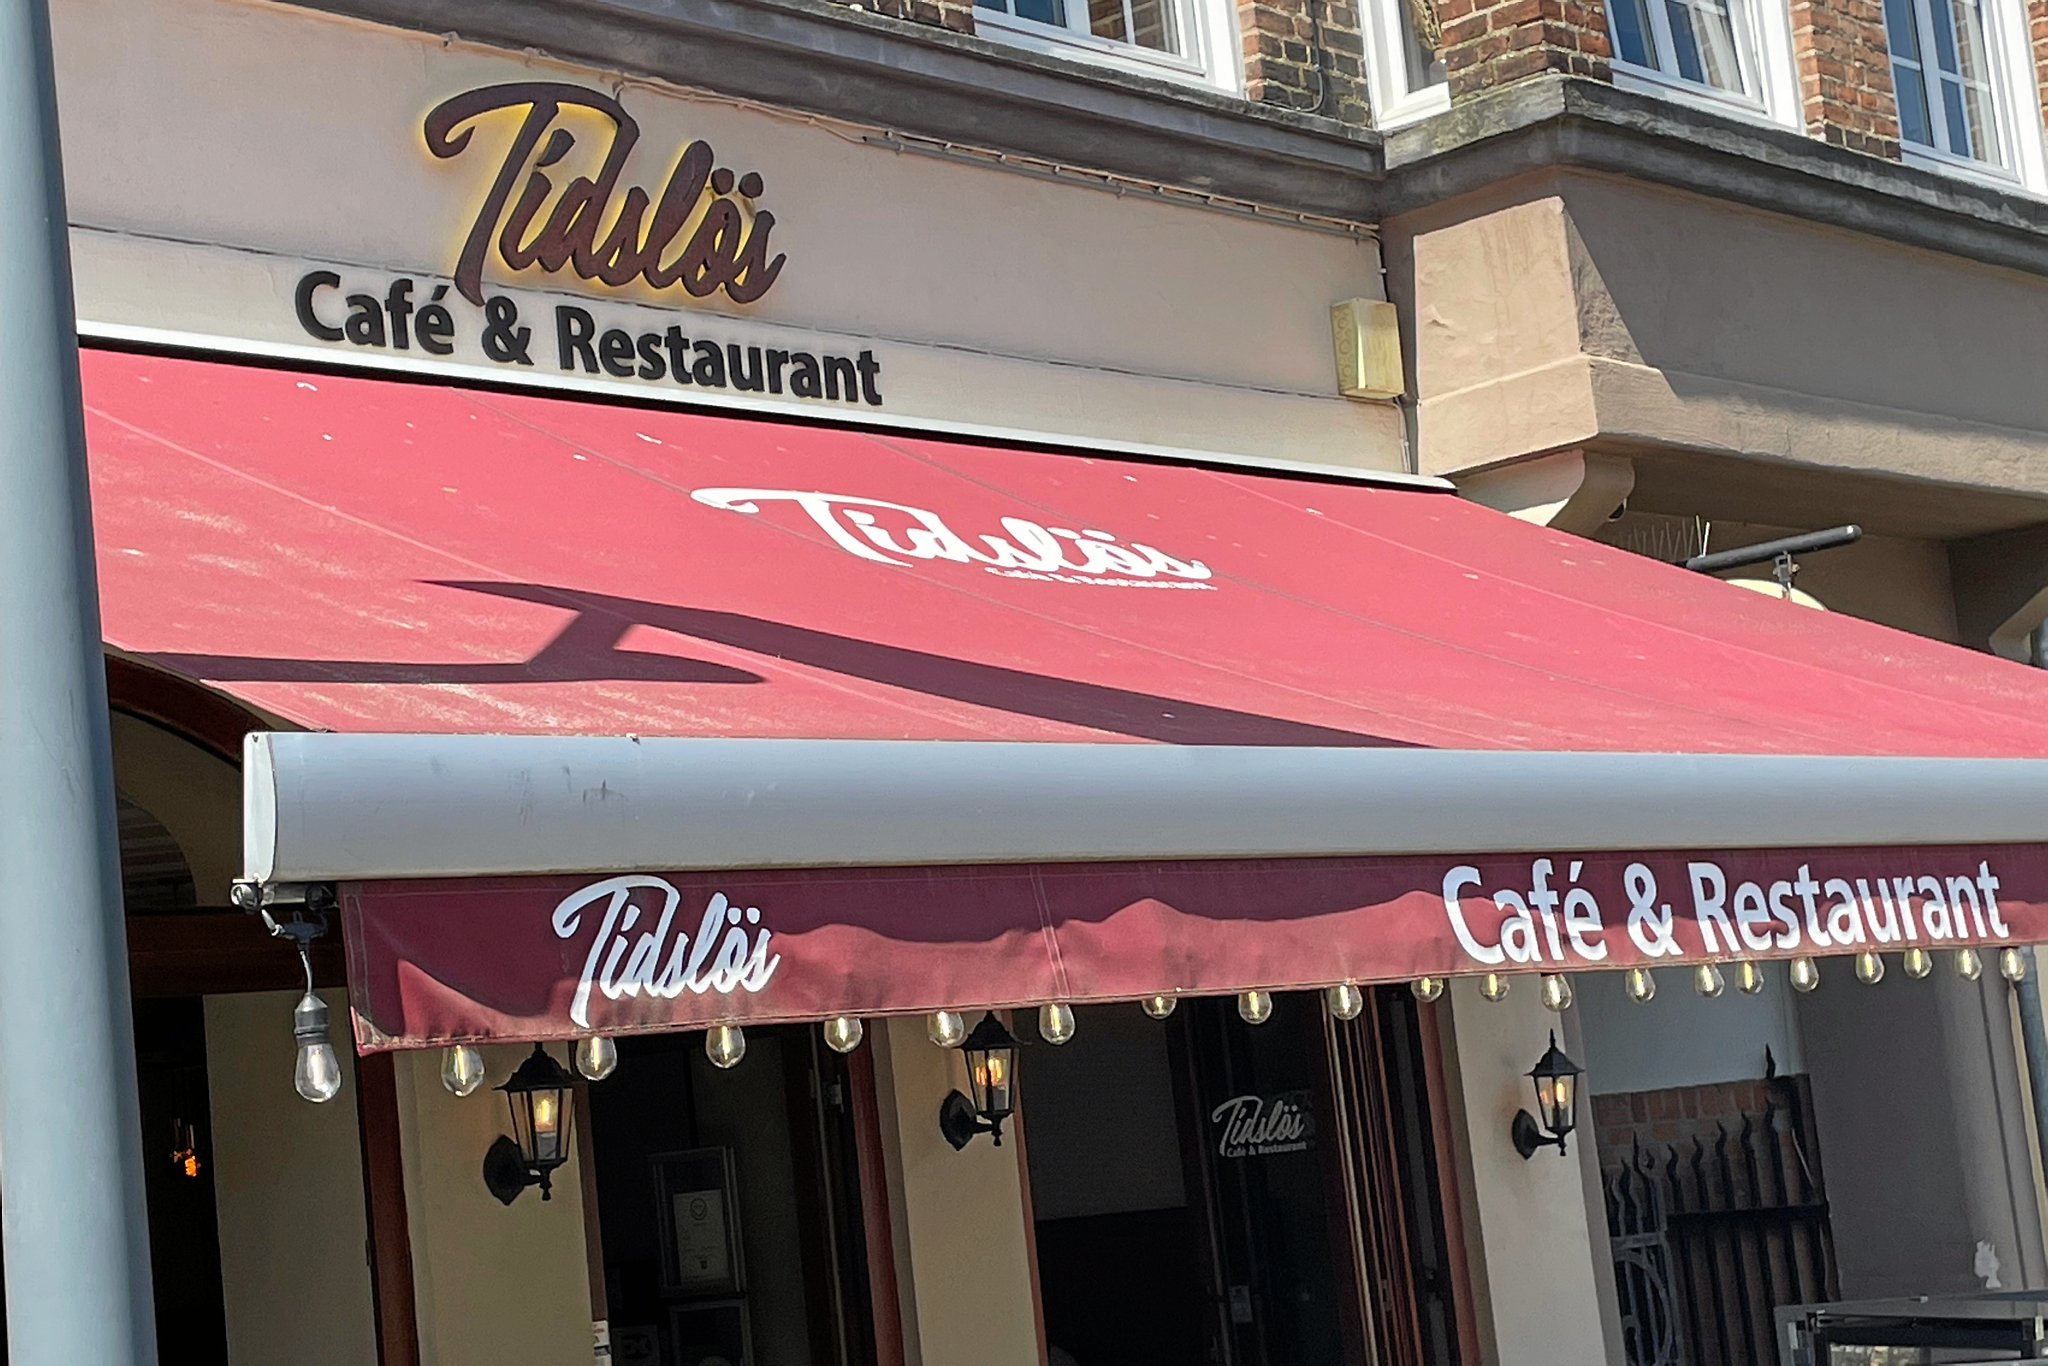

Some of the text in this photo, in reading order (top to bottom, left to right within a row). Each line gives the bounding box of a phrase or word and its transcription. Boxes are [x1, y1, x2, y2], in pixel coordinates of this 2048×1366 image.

[424, 81, 787, 307] Tidslös
[294, 269, 883, 406] Café & Restaurant
[690, 487, 1213, 580] Tidslös
[551, 874, 782, 1029] Tidslös
[1442, 857, 2009, 964] Café & Restaurant
[1212, 1095, 1305, 1157] Tidslös
